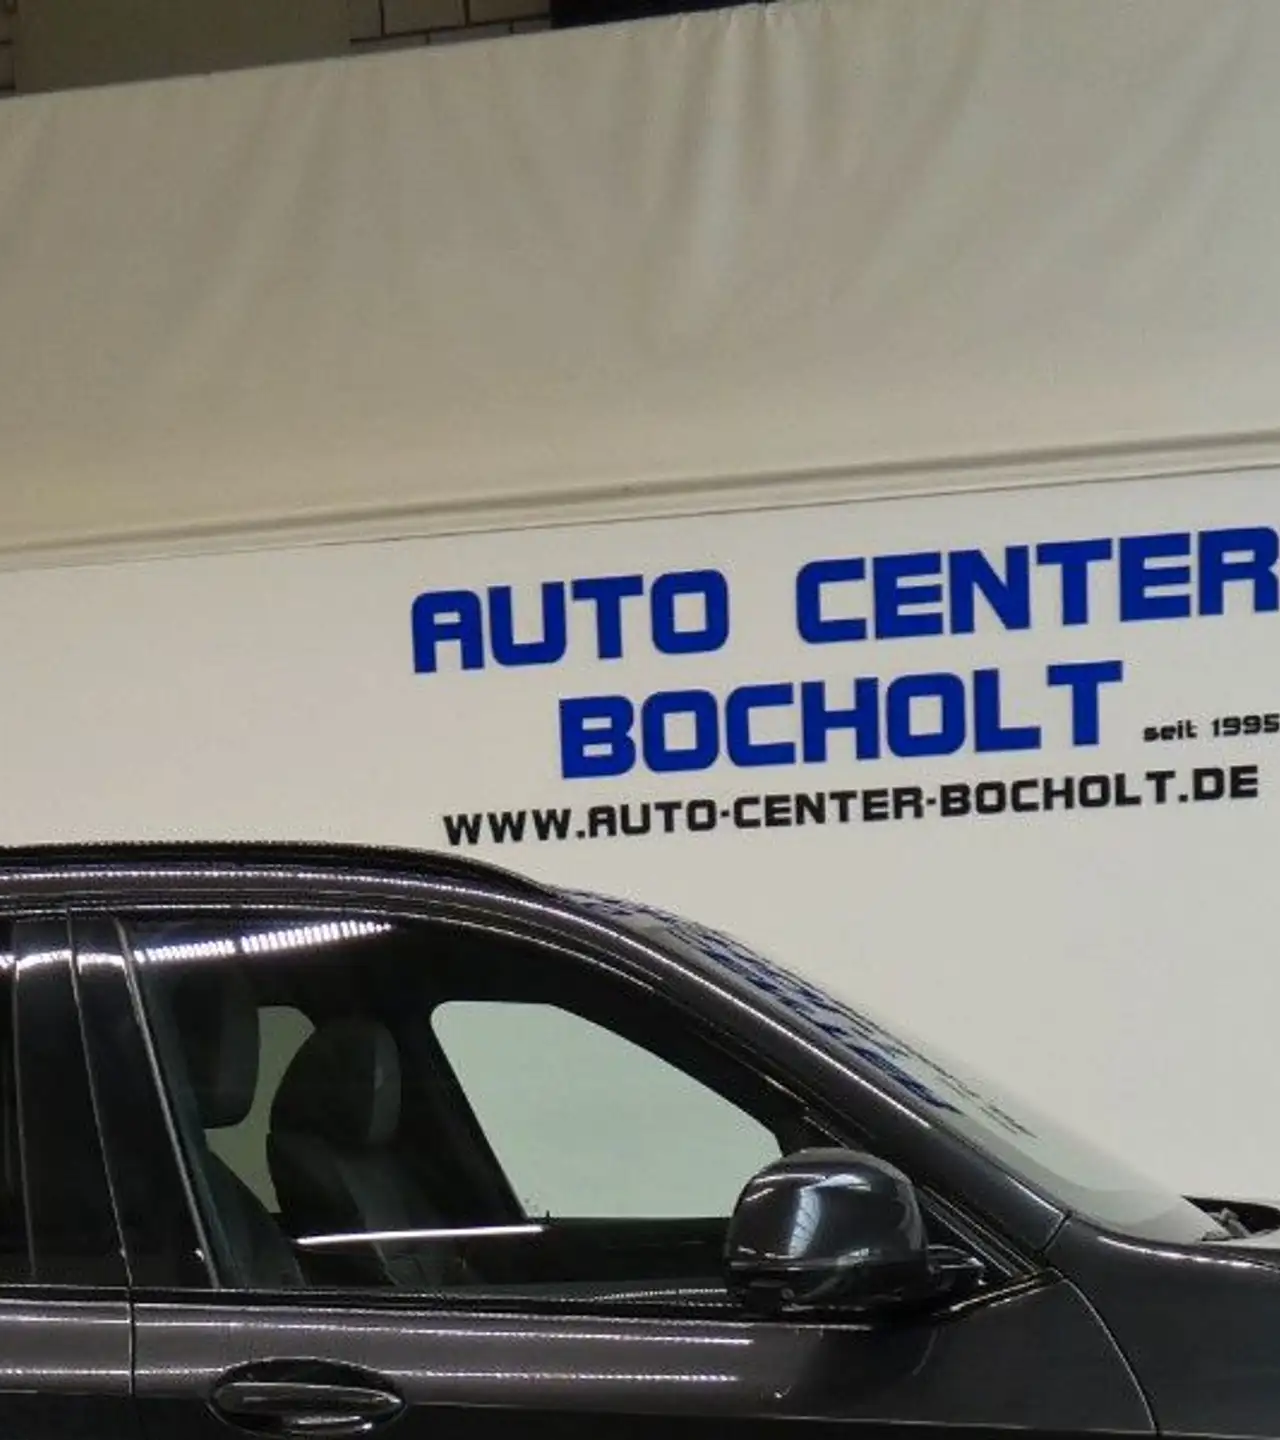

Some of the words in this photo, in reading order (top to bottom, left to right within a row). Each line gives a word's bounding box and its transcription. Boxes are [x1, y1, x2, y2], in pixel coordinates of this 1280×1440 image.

[410, 569, 730, 674] AUTO
[795, 526, 1280, 645] CENTER
[558, 660, 1123, 780] BOCHOLT
[1143, 719, 1198, 743] seit
[1210, 712, 1280, 738] 1995
[442, 764, 1259, 847] WWW.AUTO-CENTER-BOCHOLT.DE
